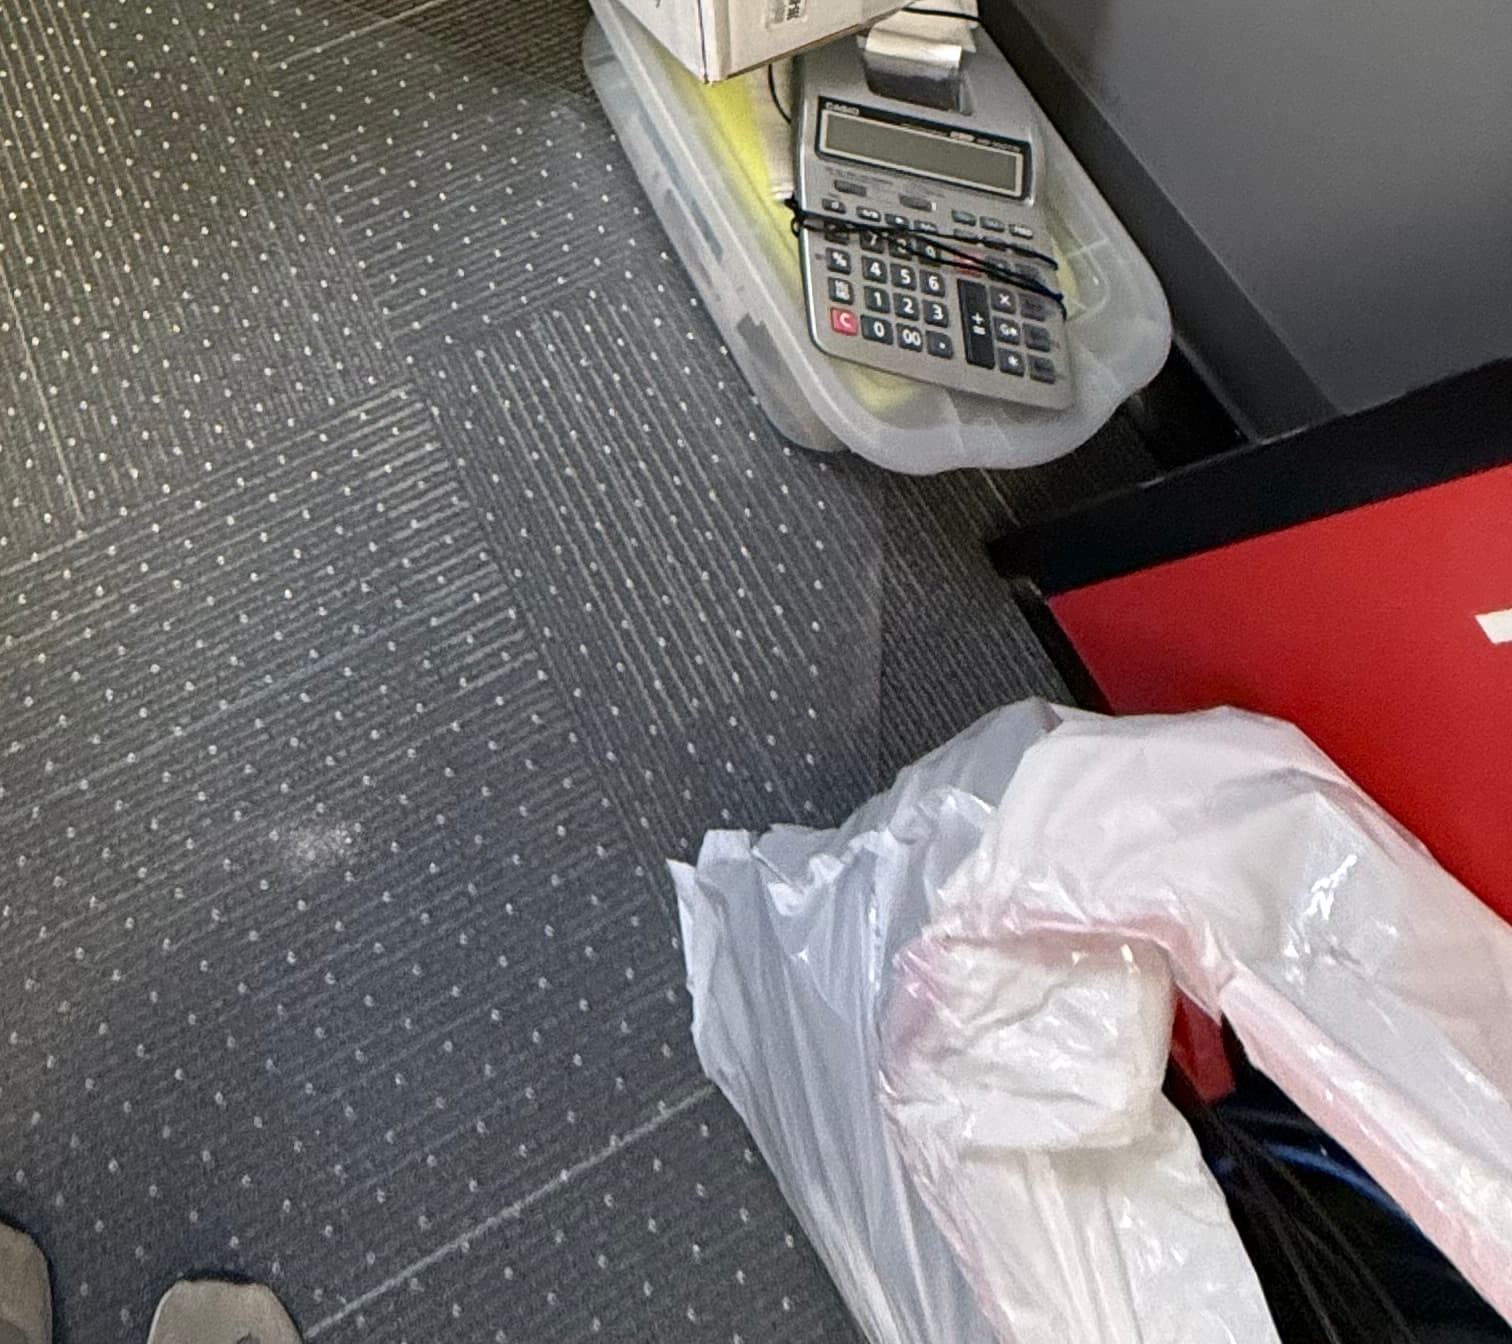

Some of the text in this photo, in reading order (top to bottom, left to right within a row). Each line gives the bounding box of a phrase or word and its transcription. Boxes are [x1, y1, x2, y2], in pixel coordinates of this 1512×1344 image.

[826, 102, 860, 116] CASIO
[870, 262, 939, 290] 4 5 6
[874, 293, 943, 321] 1 2 3
[840, 313, 921, 346] C 0 00
